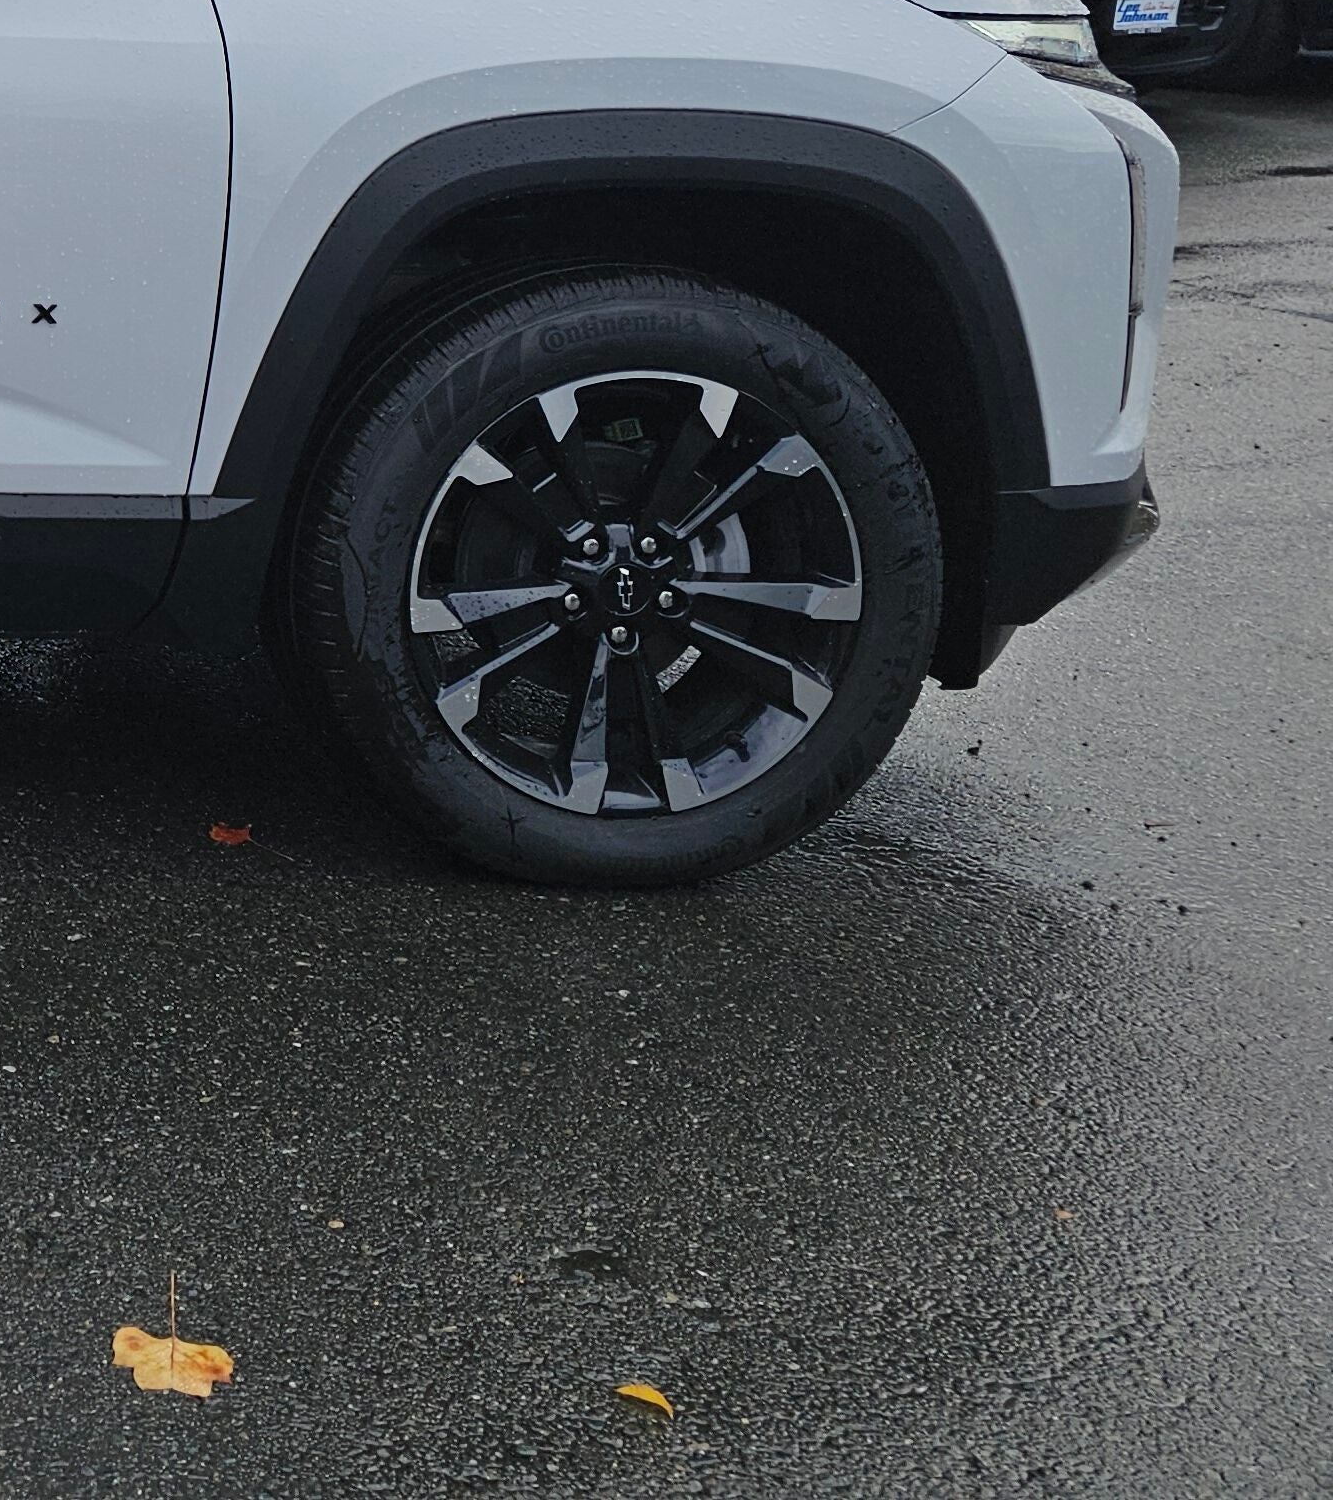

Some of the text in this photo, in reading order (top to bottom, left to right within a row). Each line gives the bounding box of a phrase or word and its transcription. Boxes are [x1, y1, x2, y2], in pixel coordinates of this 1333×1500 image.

[1117, 0, 1141, 12] Lee
[1117, 10, 1169, 23] Johnson
[539, 312, 682, 353] Continental
